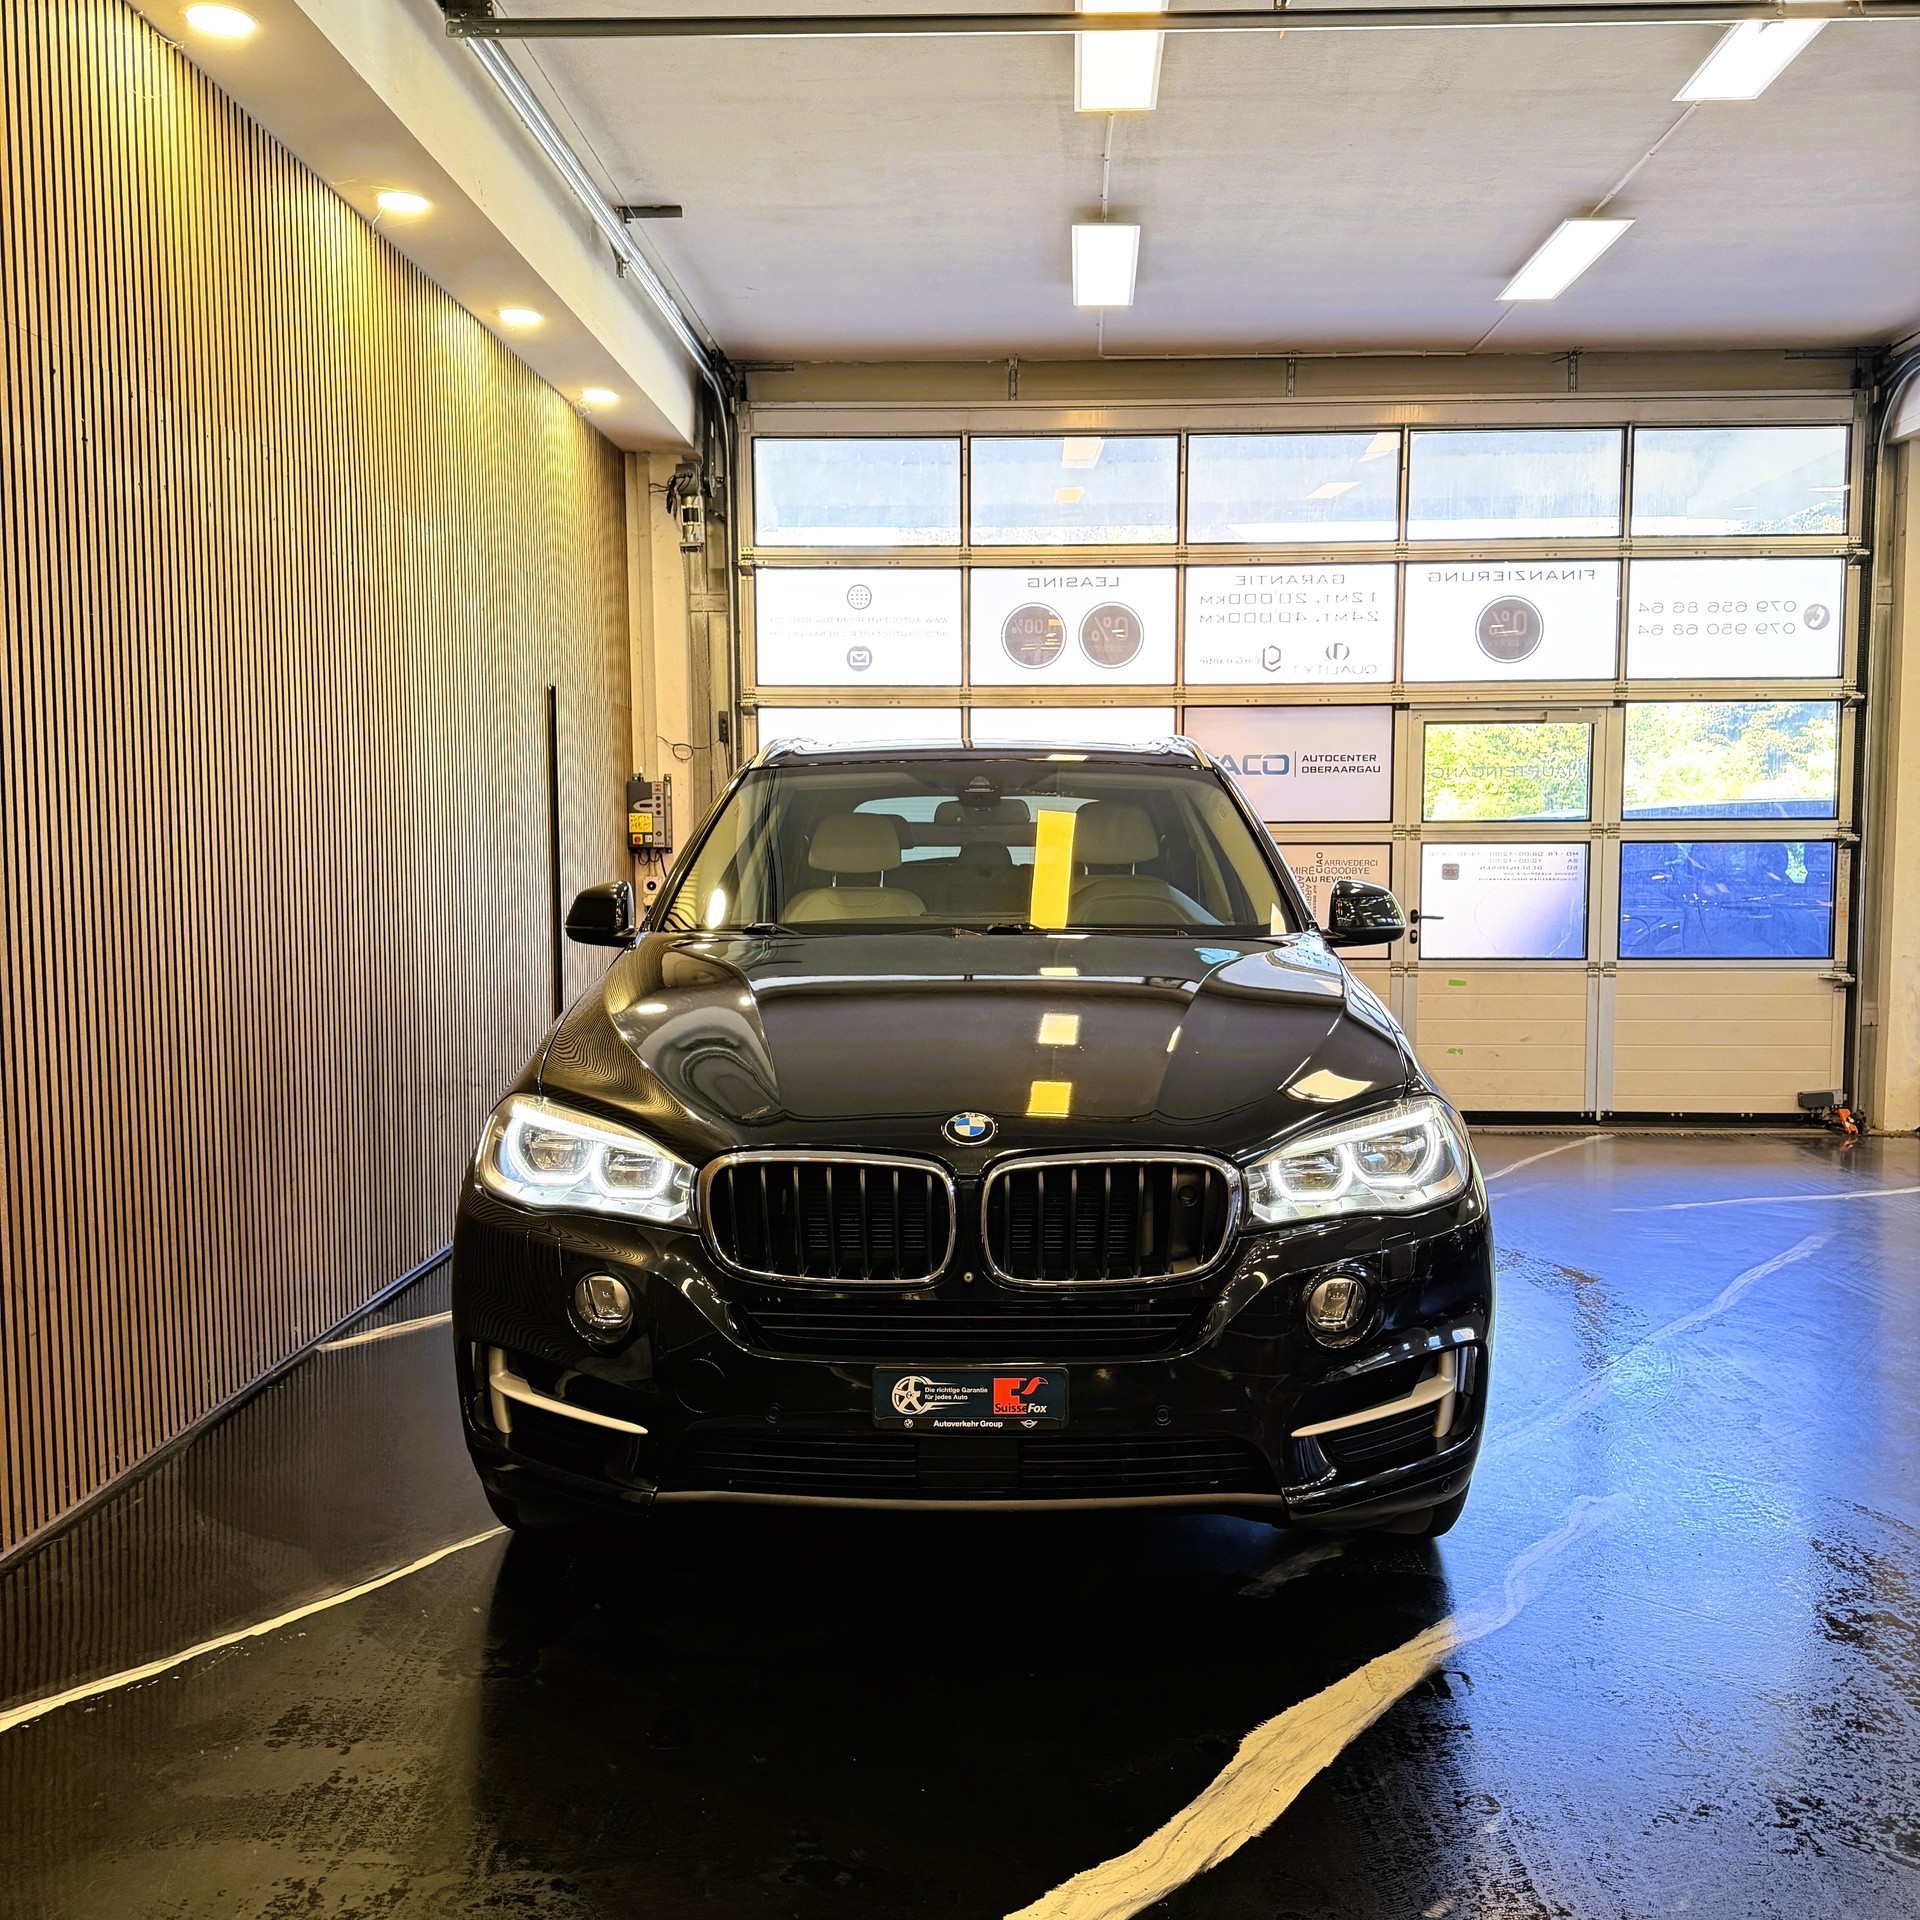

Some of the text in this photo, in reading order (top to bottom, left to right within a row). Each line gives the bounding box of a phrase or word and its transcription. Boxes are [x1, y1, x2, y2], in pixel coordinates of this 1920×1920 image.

[1301, 753, 1377, 763] AUTOCENTER
[1301, 764, 1381, 774] OBERAARGAU
[1315, 851, 1324, 874] CIAO
[1324, 859, 1378, 867] ARRIVEDERCI
[1323, 866, 1370, 875] GOODBYE
[936, 1387, 960, 1395] richtige
[994, 1403, 1047, 1413] SuisseFox
[933, 1419, 1004, 1429] Autoverkehr Group
